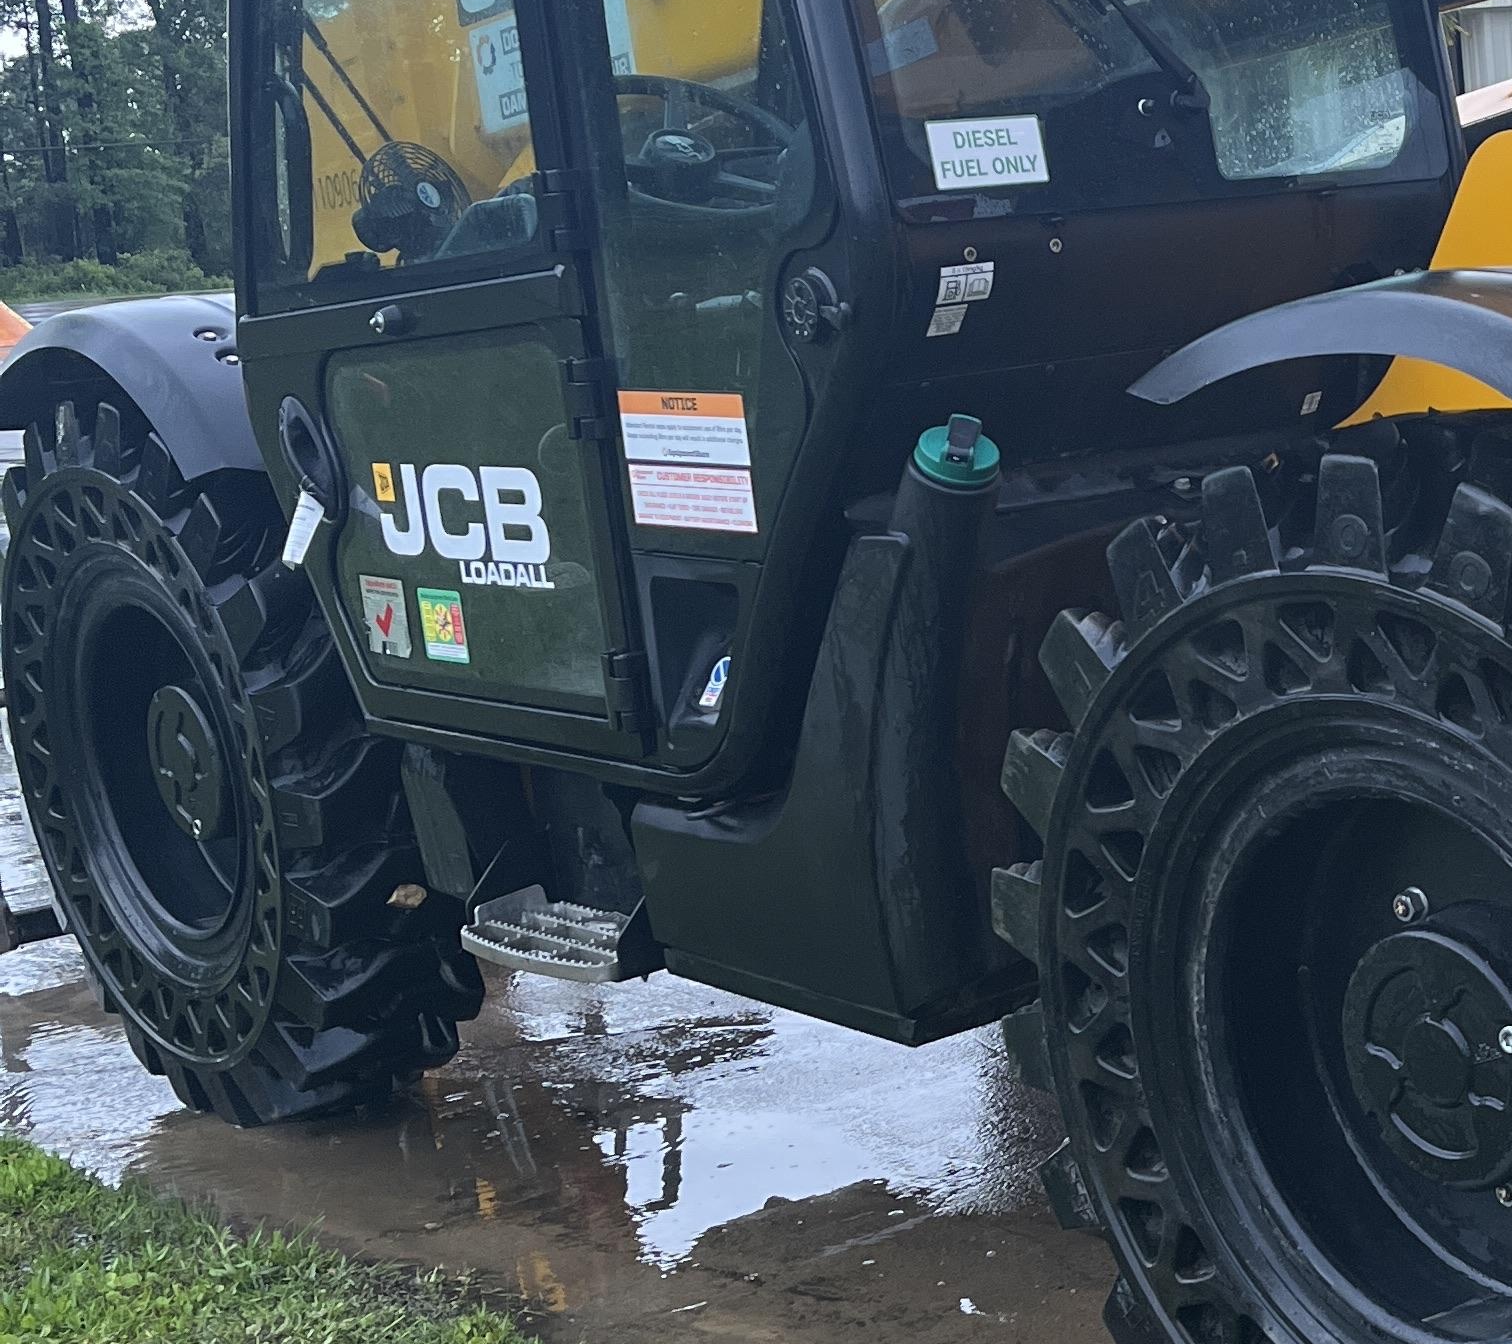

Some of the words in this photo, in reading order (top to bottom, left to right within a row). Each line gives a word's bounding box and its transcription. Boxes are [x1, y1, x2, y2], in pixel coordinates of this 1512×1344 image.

[953, 128, 1018, 149] DIESEL
[940, 159, 988, 179] FUEL
[992, 154, 1038, 175] ONLY
[661, 396, 699, 411] NOTICE
[656, 471, 692, 482] CUSTOMER
[693, 473, 749, 486] RESPONSIBILITY
[380, 463, 551, 565] JCB
[459, 560, 555, 589] LOADALL
